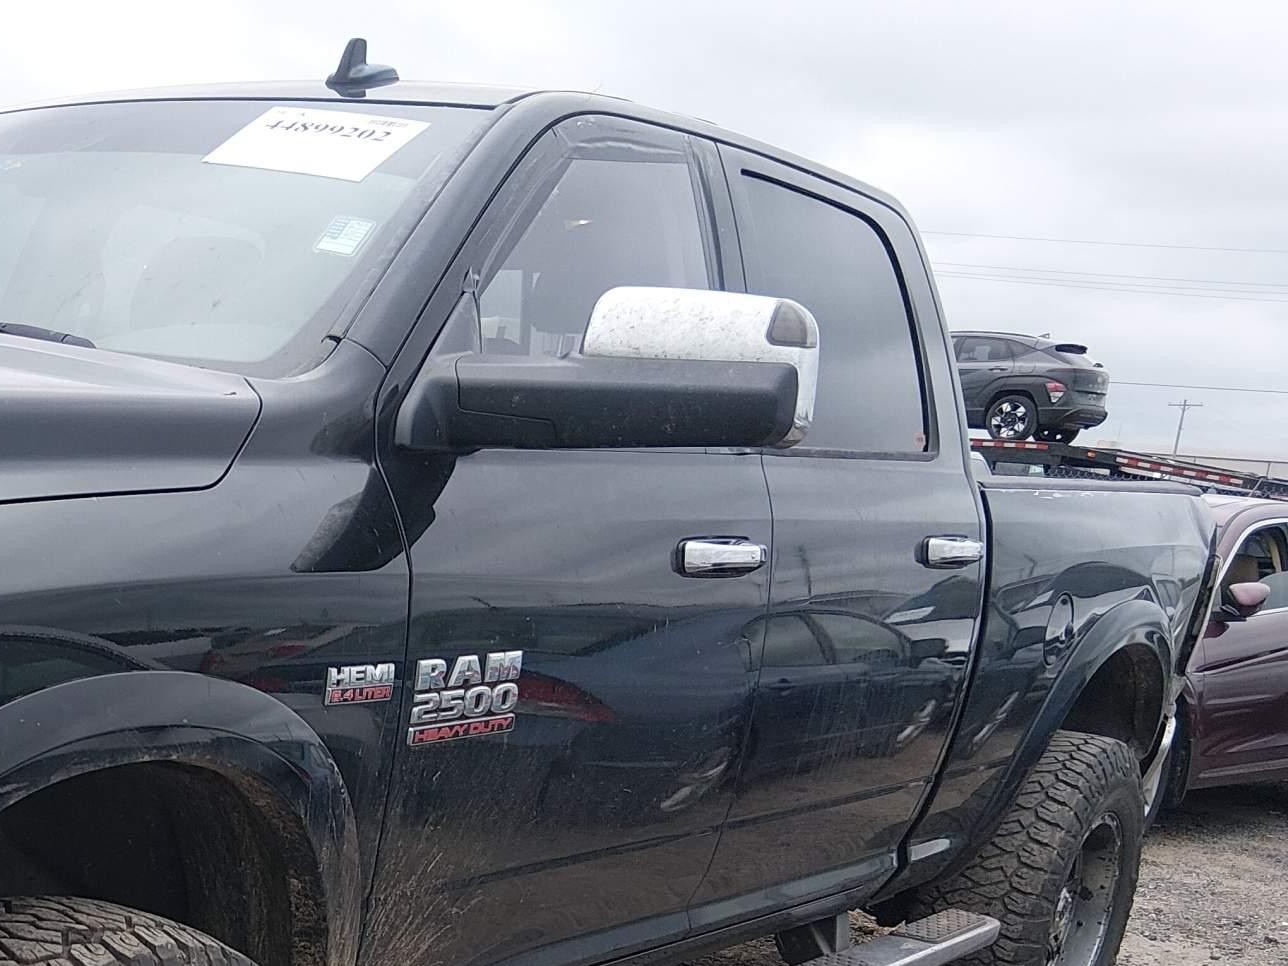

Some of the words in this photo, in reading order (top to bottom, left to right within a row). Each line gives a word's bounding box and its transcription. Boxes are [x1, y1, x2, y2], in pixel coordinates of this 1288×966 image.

[265, 119, 393, 142] 44899202
[327, 663, 395, 688] HEMI
[416, 650, 523, 691] RAM
[354, 686, 392, 700] LITER
[410, 682, 519, 724] 2500
[414, 723, 468, 743] HEAVY
[469, 717, 513, 735] DUTY
